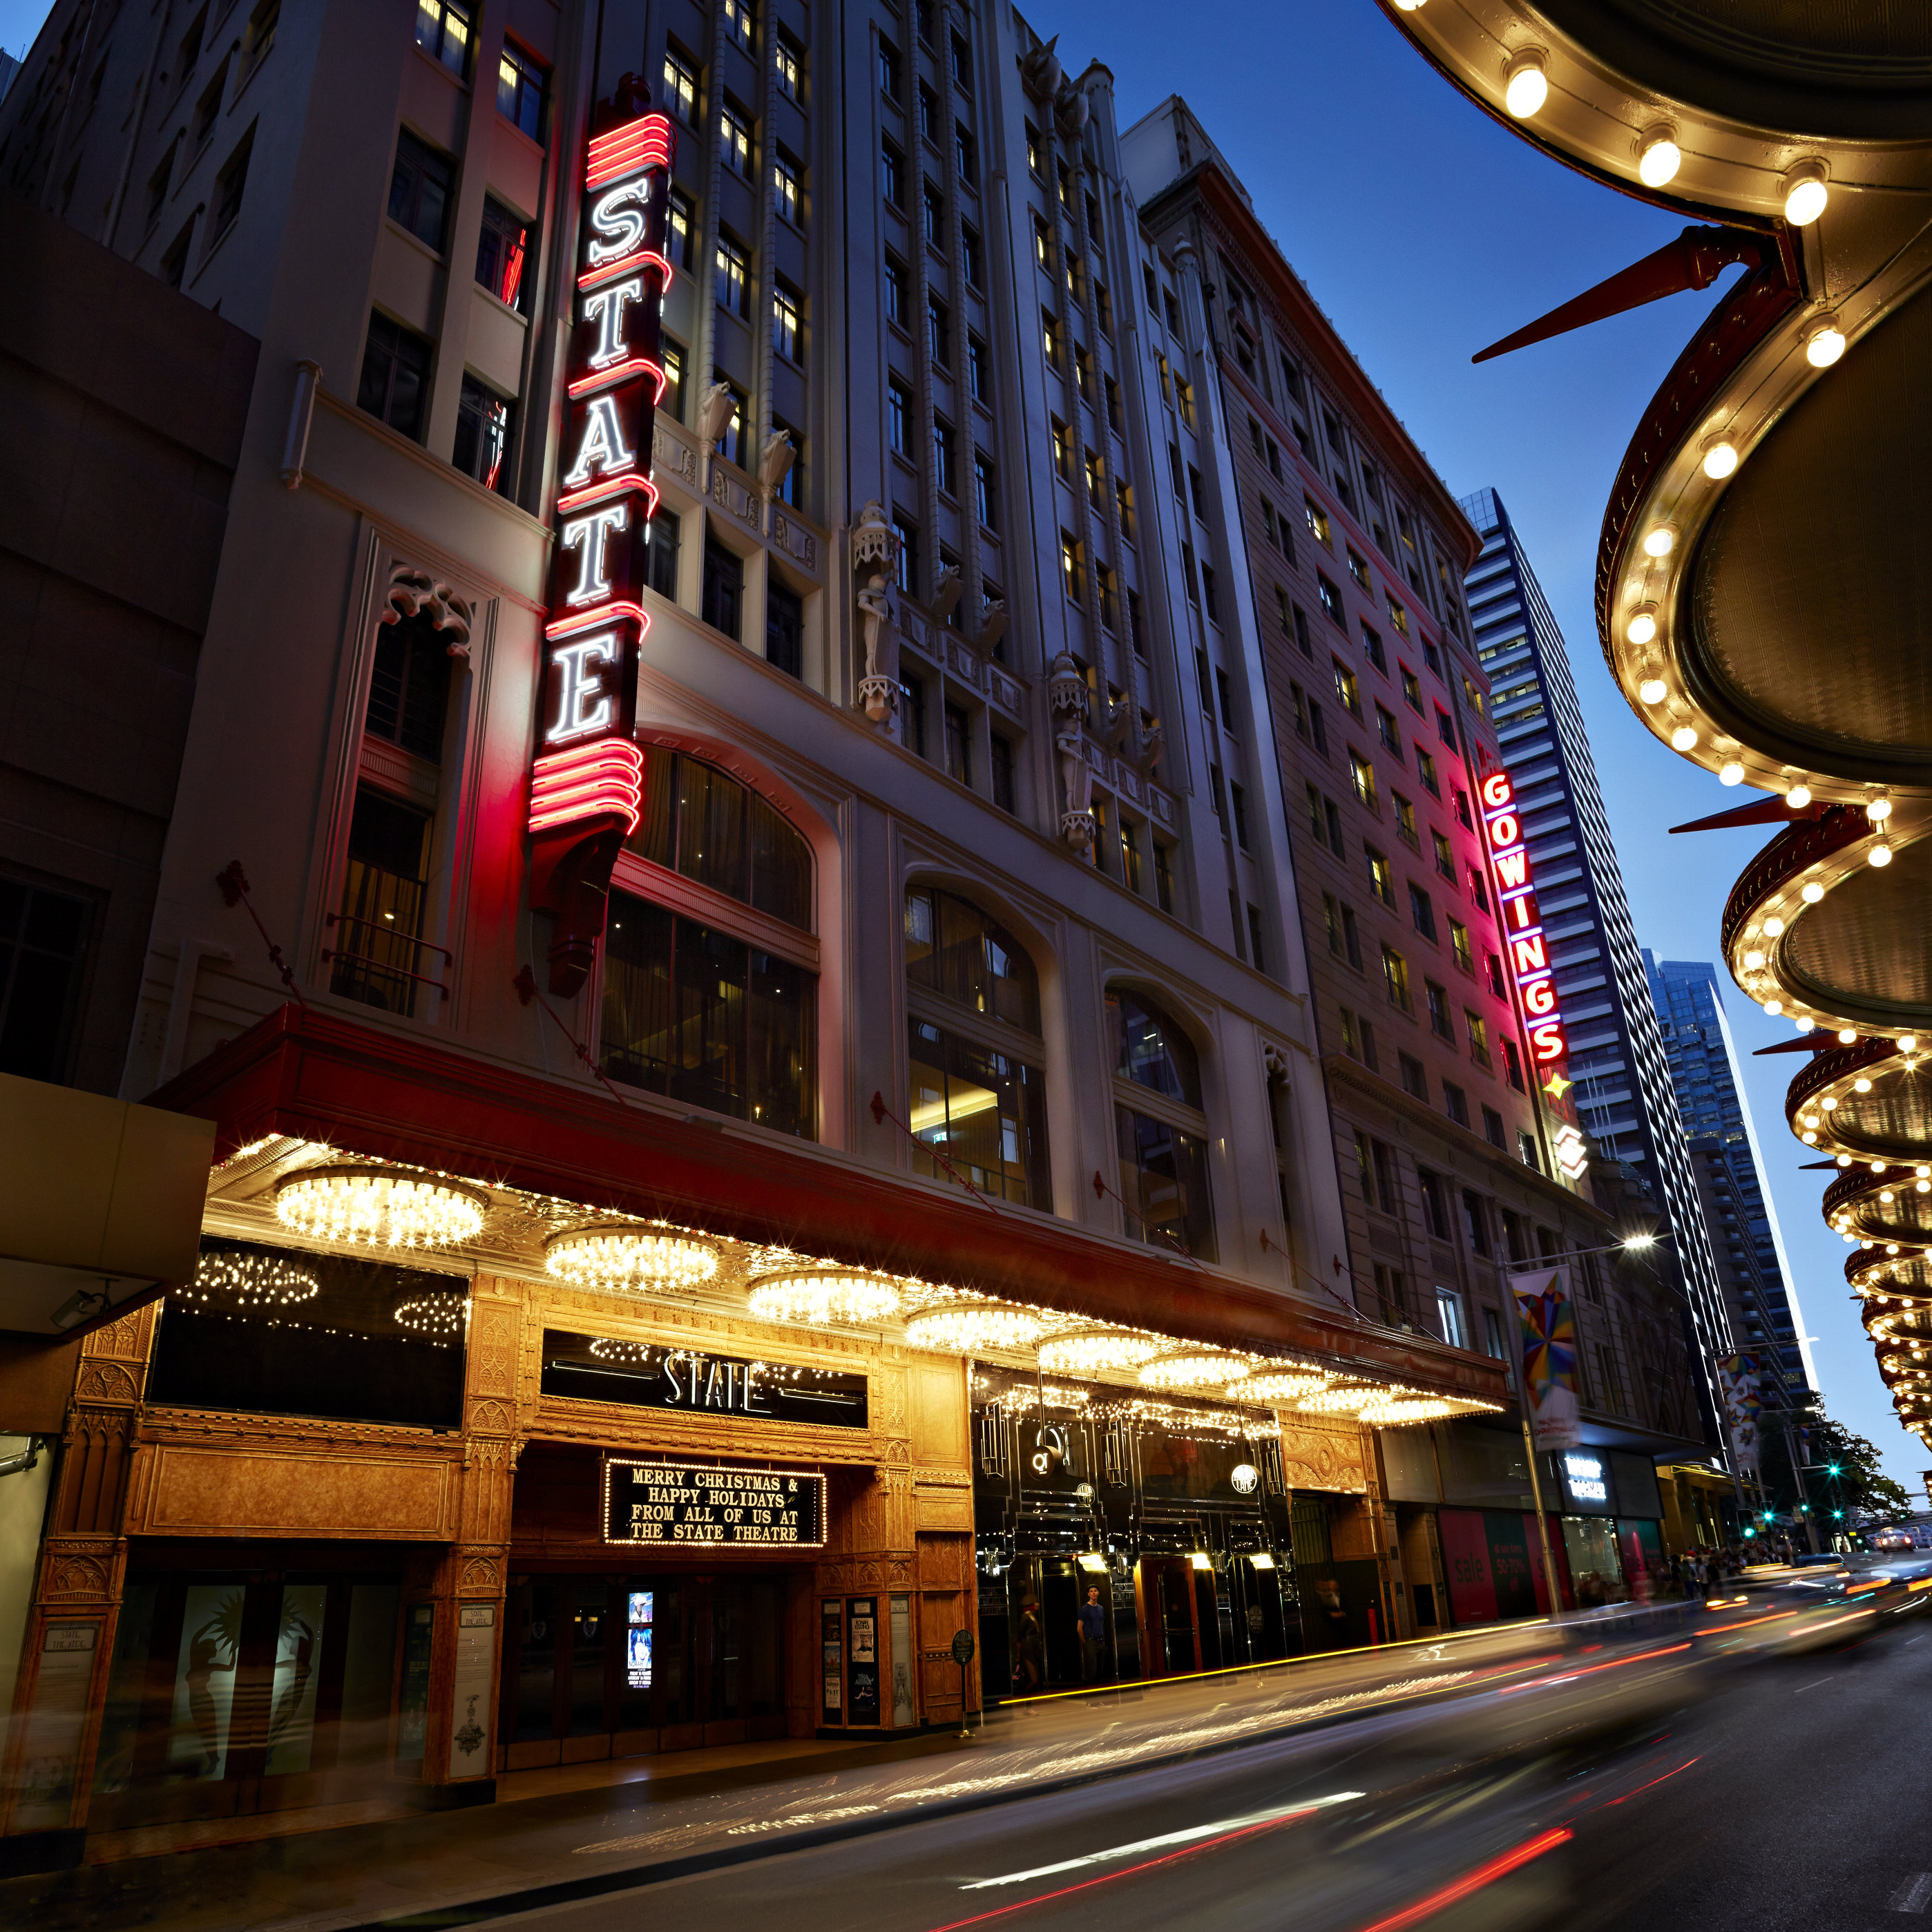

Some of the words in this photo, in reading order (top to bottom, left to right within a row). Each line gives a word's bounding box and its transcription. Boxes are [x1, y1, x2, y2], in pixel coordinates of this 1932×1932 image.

[548, 177, 651, 746] STATE
[1484, 774, 1563, 1060] GOWINGS
[663, 1354, 773, 1414] STATE
[1033, 1453, 1048, 1471] QT
[632, 1468, 685, 1486] MERRY
[695, 1472, 781, 1491] CHRISTMAS
[789, 1478, 798, 1492] &
[649, 1487, 700, 1504] HAPPY
[709, 1490, 785, 1508] HOLIDAYS
[631, 1504, 674, 1521] FROM
[685, 1507, 714, 1522] ALL
[724, 1508, 743, 1523] OF
[752, 1509, 772, 1524] US
[780, 1511, 798, 1525] AT
[631, 1522, 663, 1539] THE
[674, 1524, 723, 1540] STATE
[734, 1526, 798, 1541] THEATRE
[1455, 1552, 1483, 1582] sale
[1497, 1558, 1525, 1574] 50-70%
[53, 1641, 86, 1649] THEATRE
